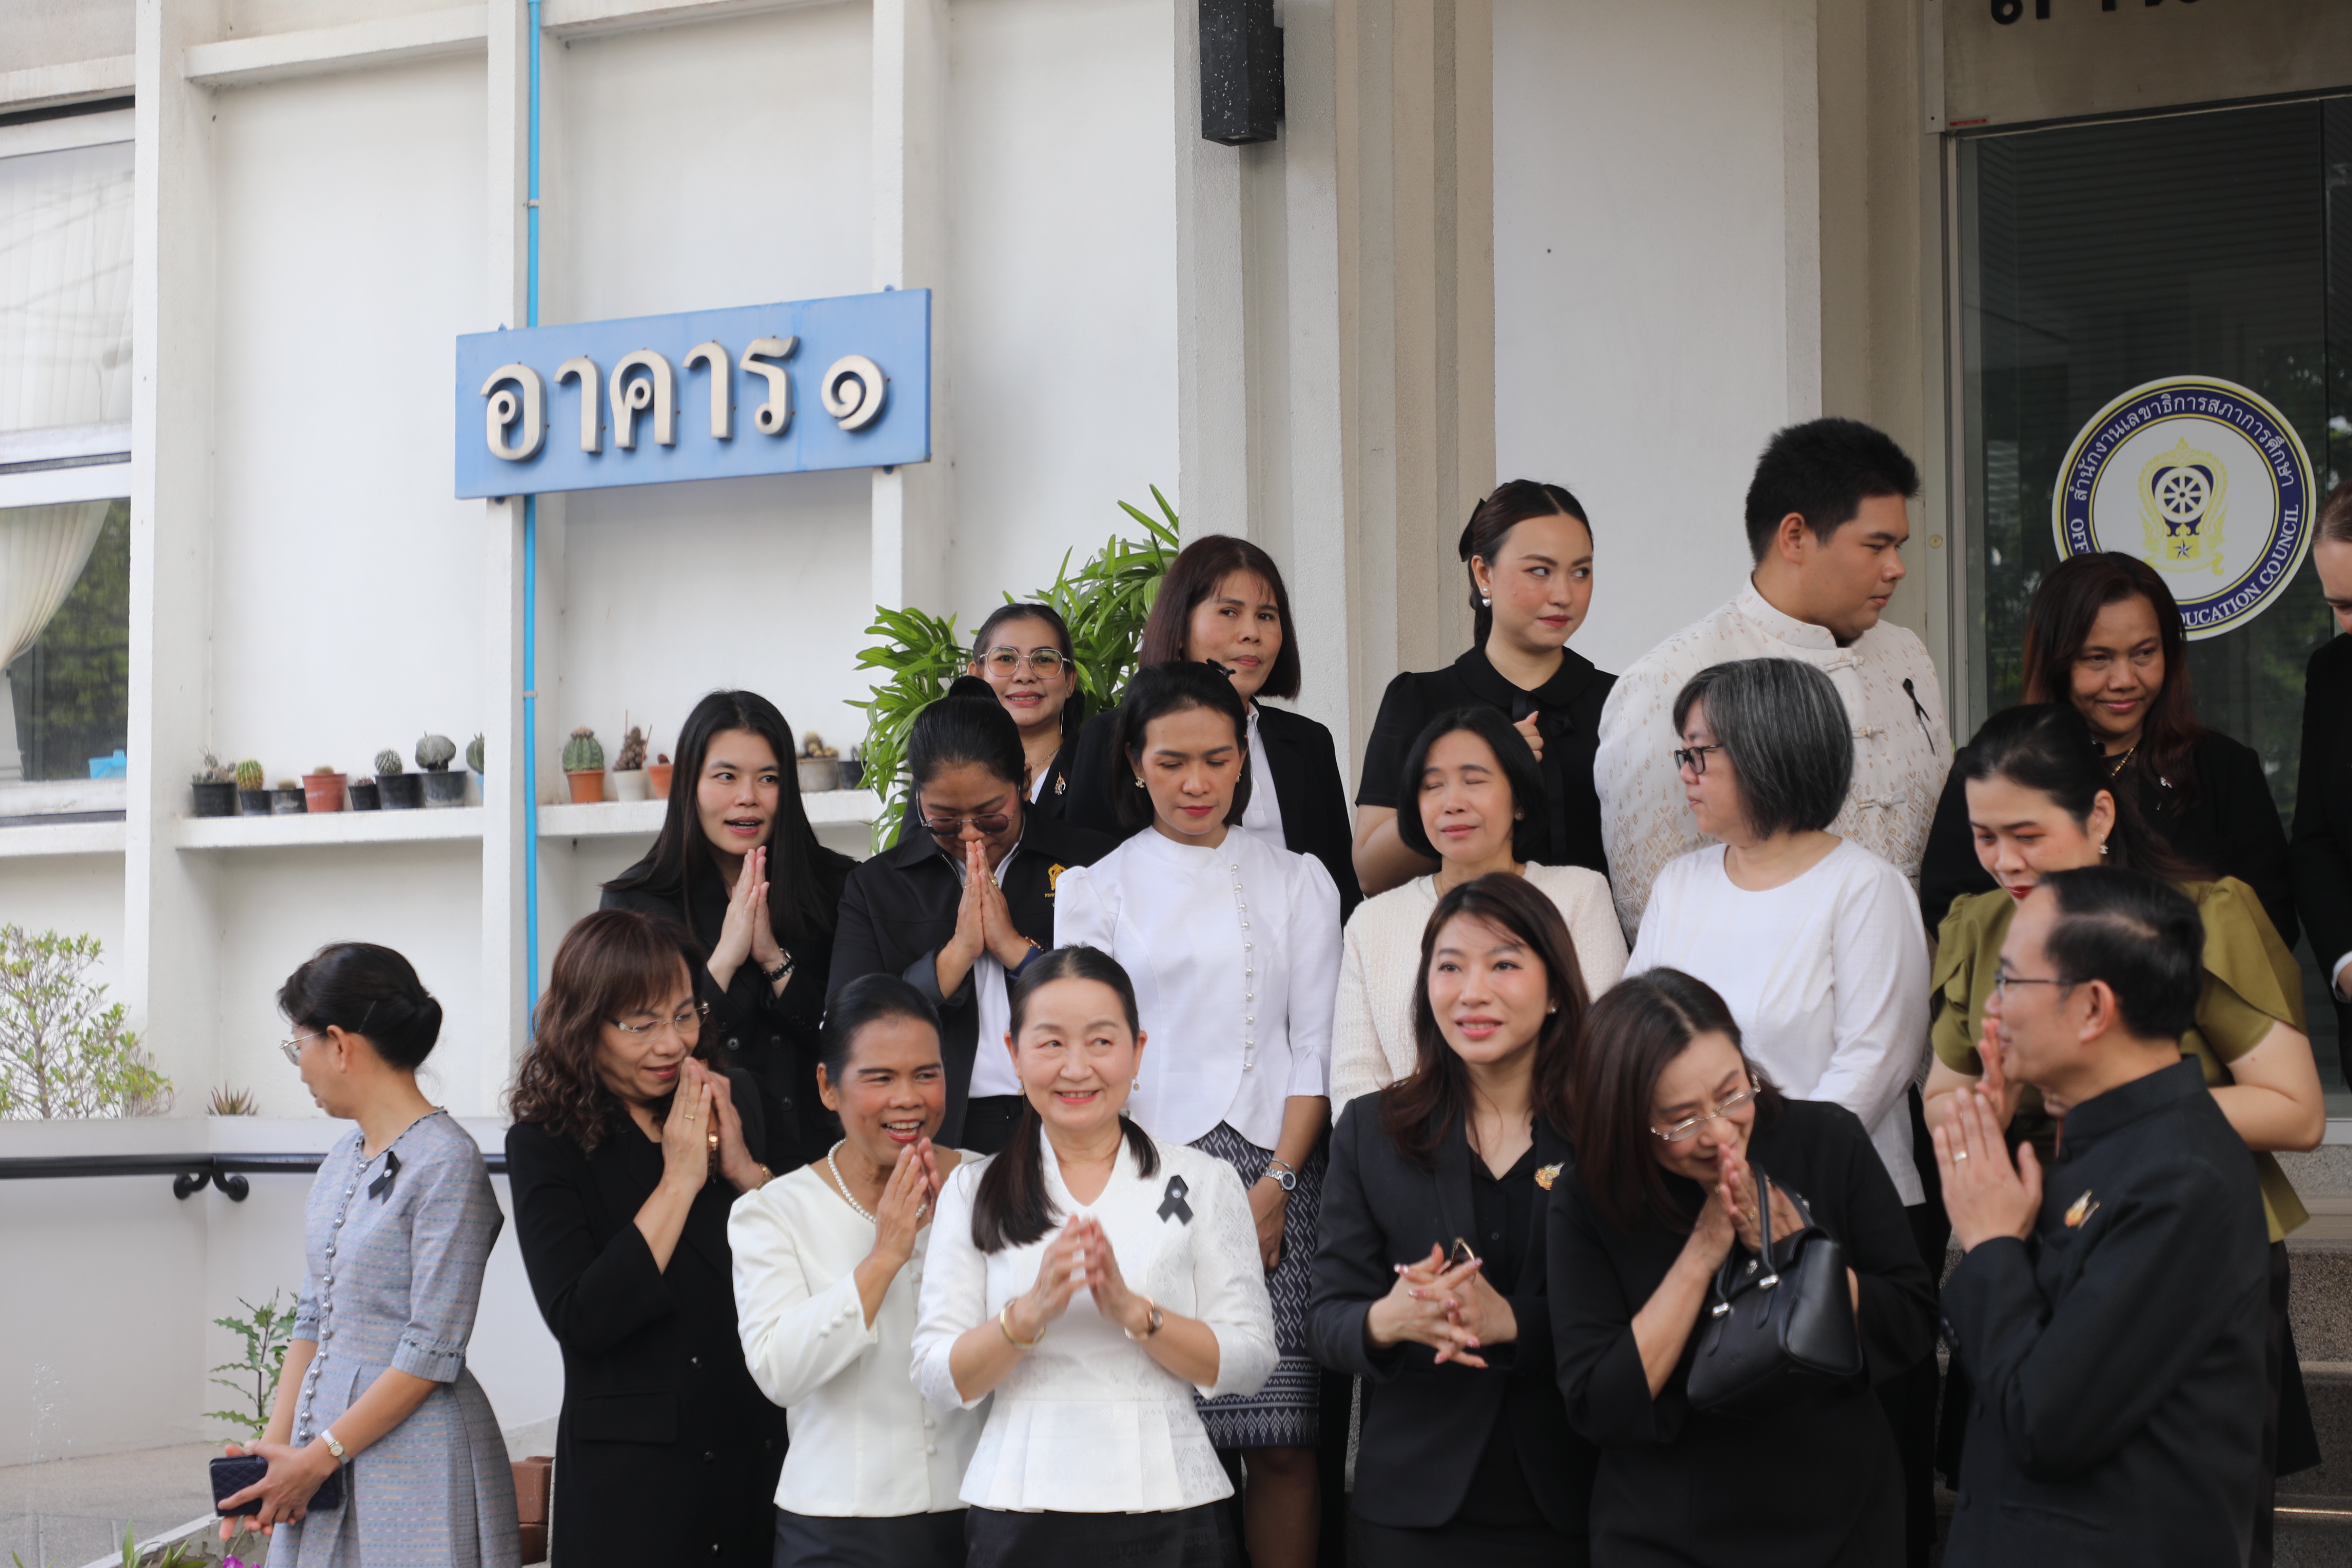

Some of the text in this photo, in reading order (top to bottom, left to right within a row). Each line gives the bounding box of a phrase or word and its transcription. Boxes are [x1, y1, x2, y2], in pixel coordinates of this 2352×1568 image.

[480, 335, 889, 462] อาคาร ๑
[2069, 393, 2294, 501] สำนักงานเลขาธิการสภาการศึกษา
[2070, 518, 2091, 553] OFF
[2259, 504, 2299, 585] COUNCIL
